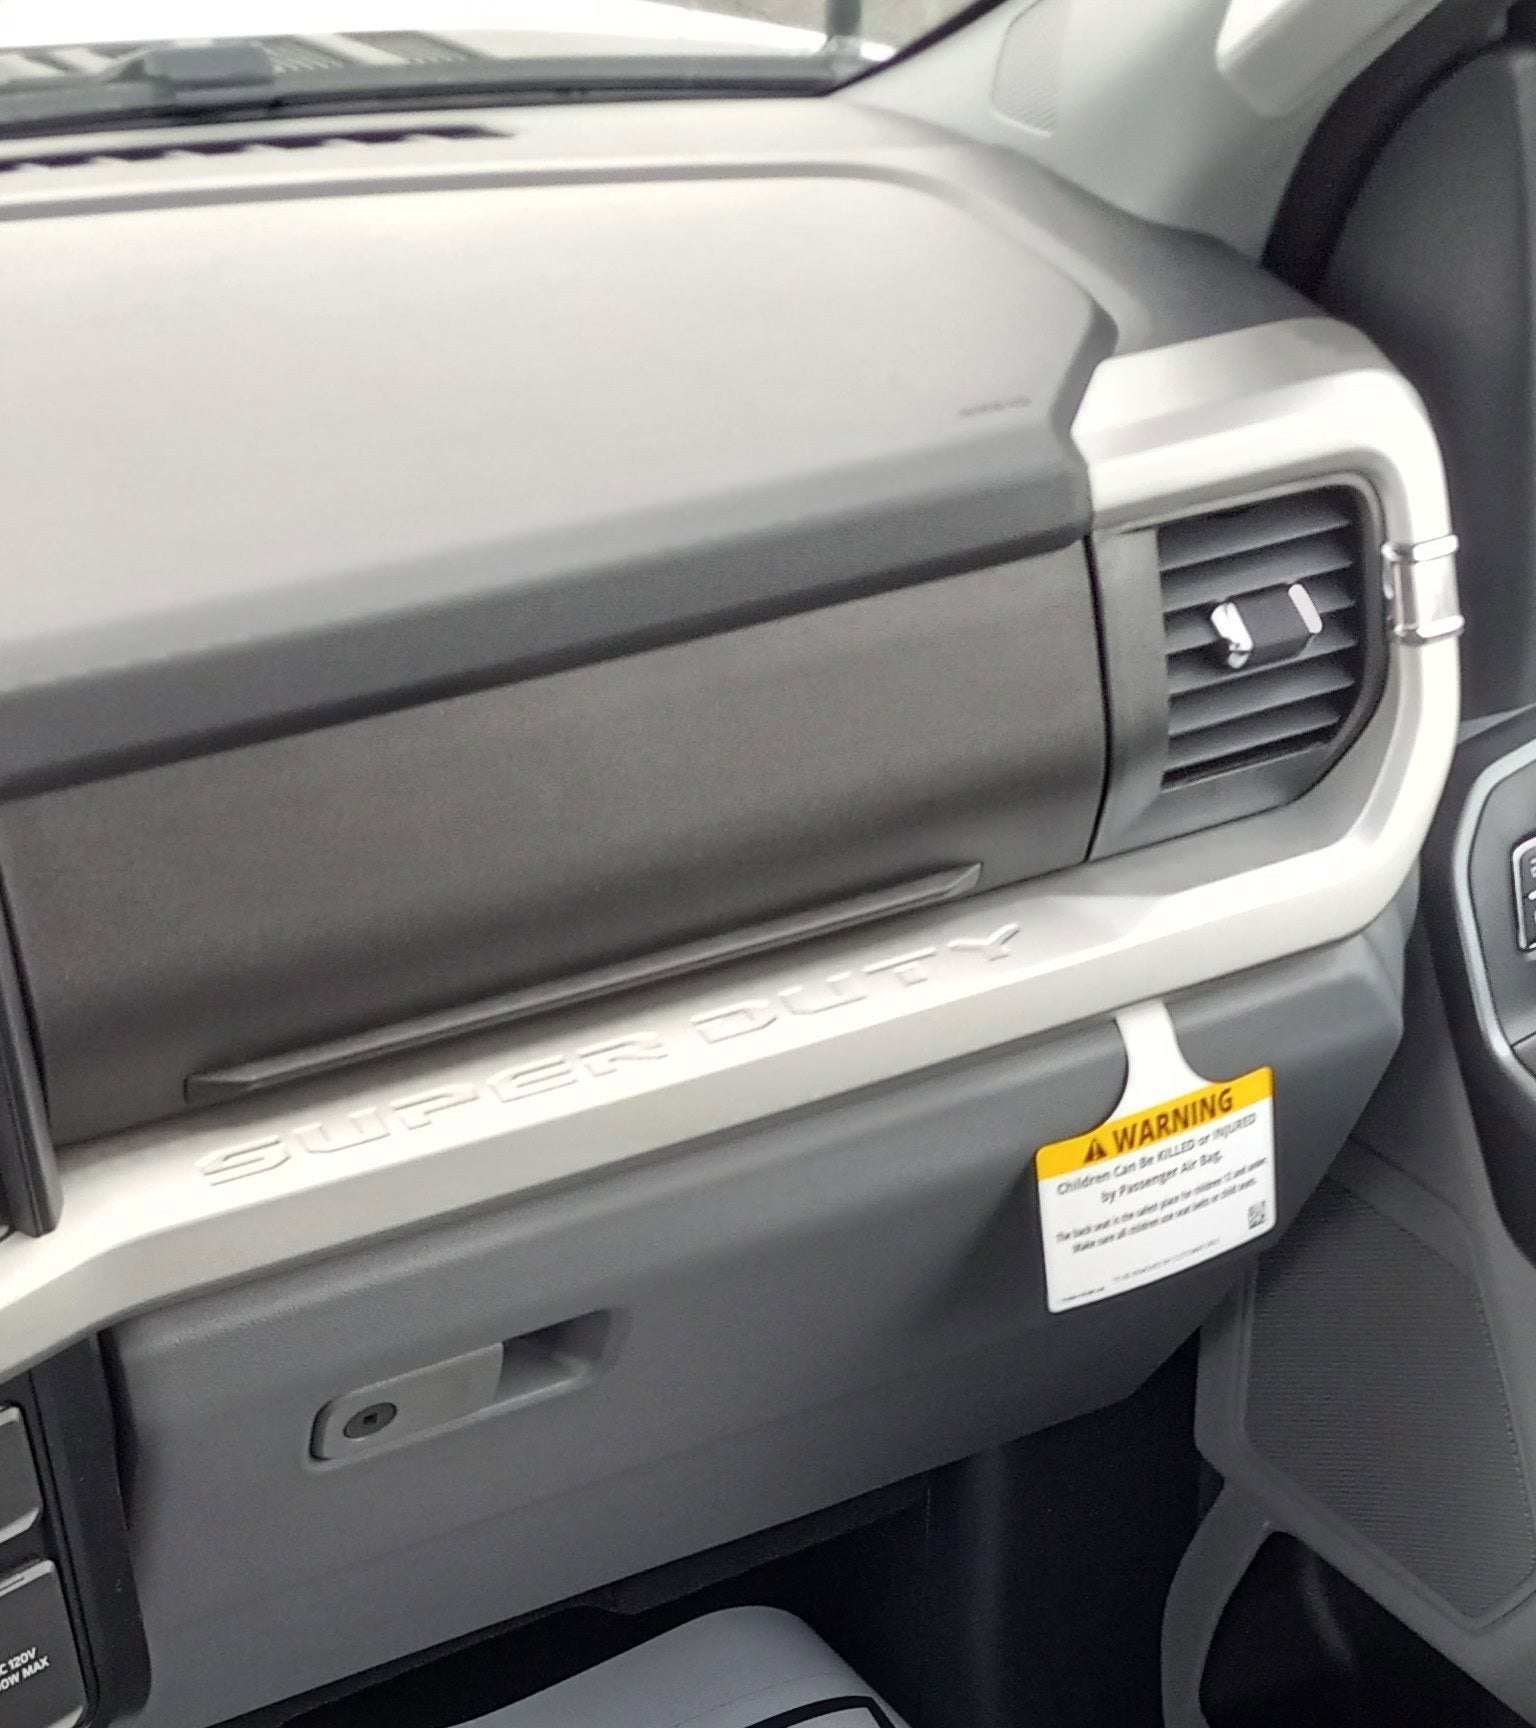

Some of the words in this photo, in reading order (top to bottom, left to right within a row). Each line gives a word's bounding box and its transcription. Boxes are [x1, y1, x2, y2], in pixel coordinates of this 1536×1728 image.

[196, 1031, 669, 1186] SUPER
[690, 921, 1023, 1044] DUTY
[1112, 1087, 1234, 1153] WARNING
[1057, 1170, 1111, 1195] Children
[1113, 1162, 1136, 1178] Can
[1139, 1156, 1154, 1169] Be
[1157, 1138, 1195, 1162] KILLED
[1198, 1132, 1210, 1146] or
[1101, 1190, 1117, 1204] by
[1119, 1167, 1179, 1197] Passenger
[1181, 1160, 1198, 1174] Air
[8, 1647, 37, 1673] 120V
[21, 1655, 51, 1680] MAX
